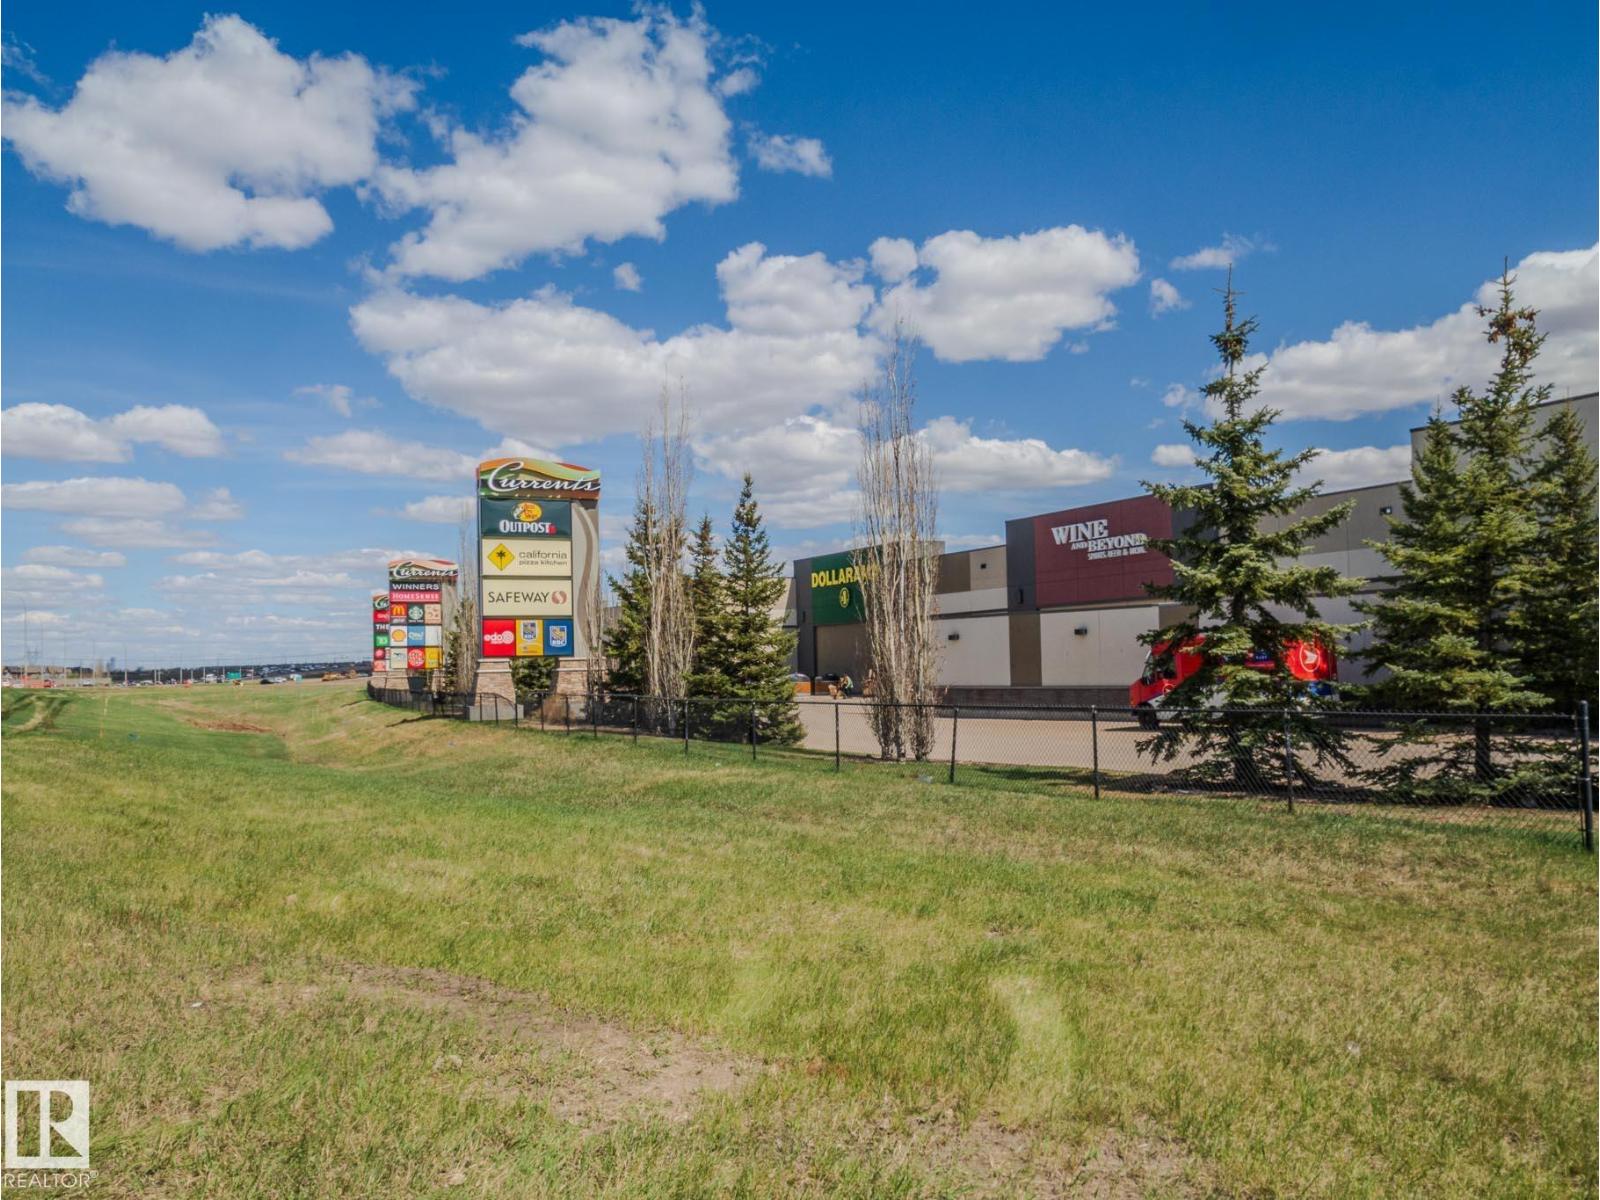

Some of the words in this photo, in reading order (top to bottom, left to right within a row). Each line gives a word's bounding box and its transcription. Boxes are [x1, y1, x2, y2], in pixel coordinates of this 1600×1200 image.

[488, 461, 601, 492] Currents
[499, 520, 551, 533] OUTPOST
[1051, 519, 1108, 545] WINE
[1071, 542, 1087, 550] AND
[1088, 533, 1147, 552] BEYOND
[519, 550, 567, 559] california
[488, 591, 549, 603] SAFEWAY
